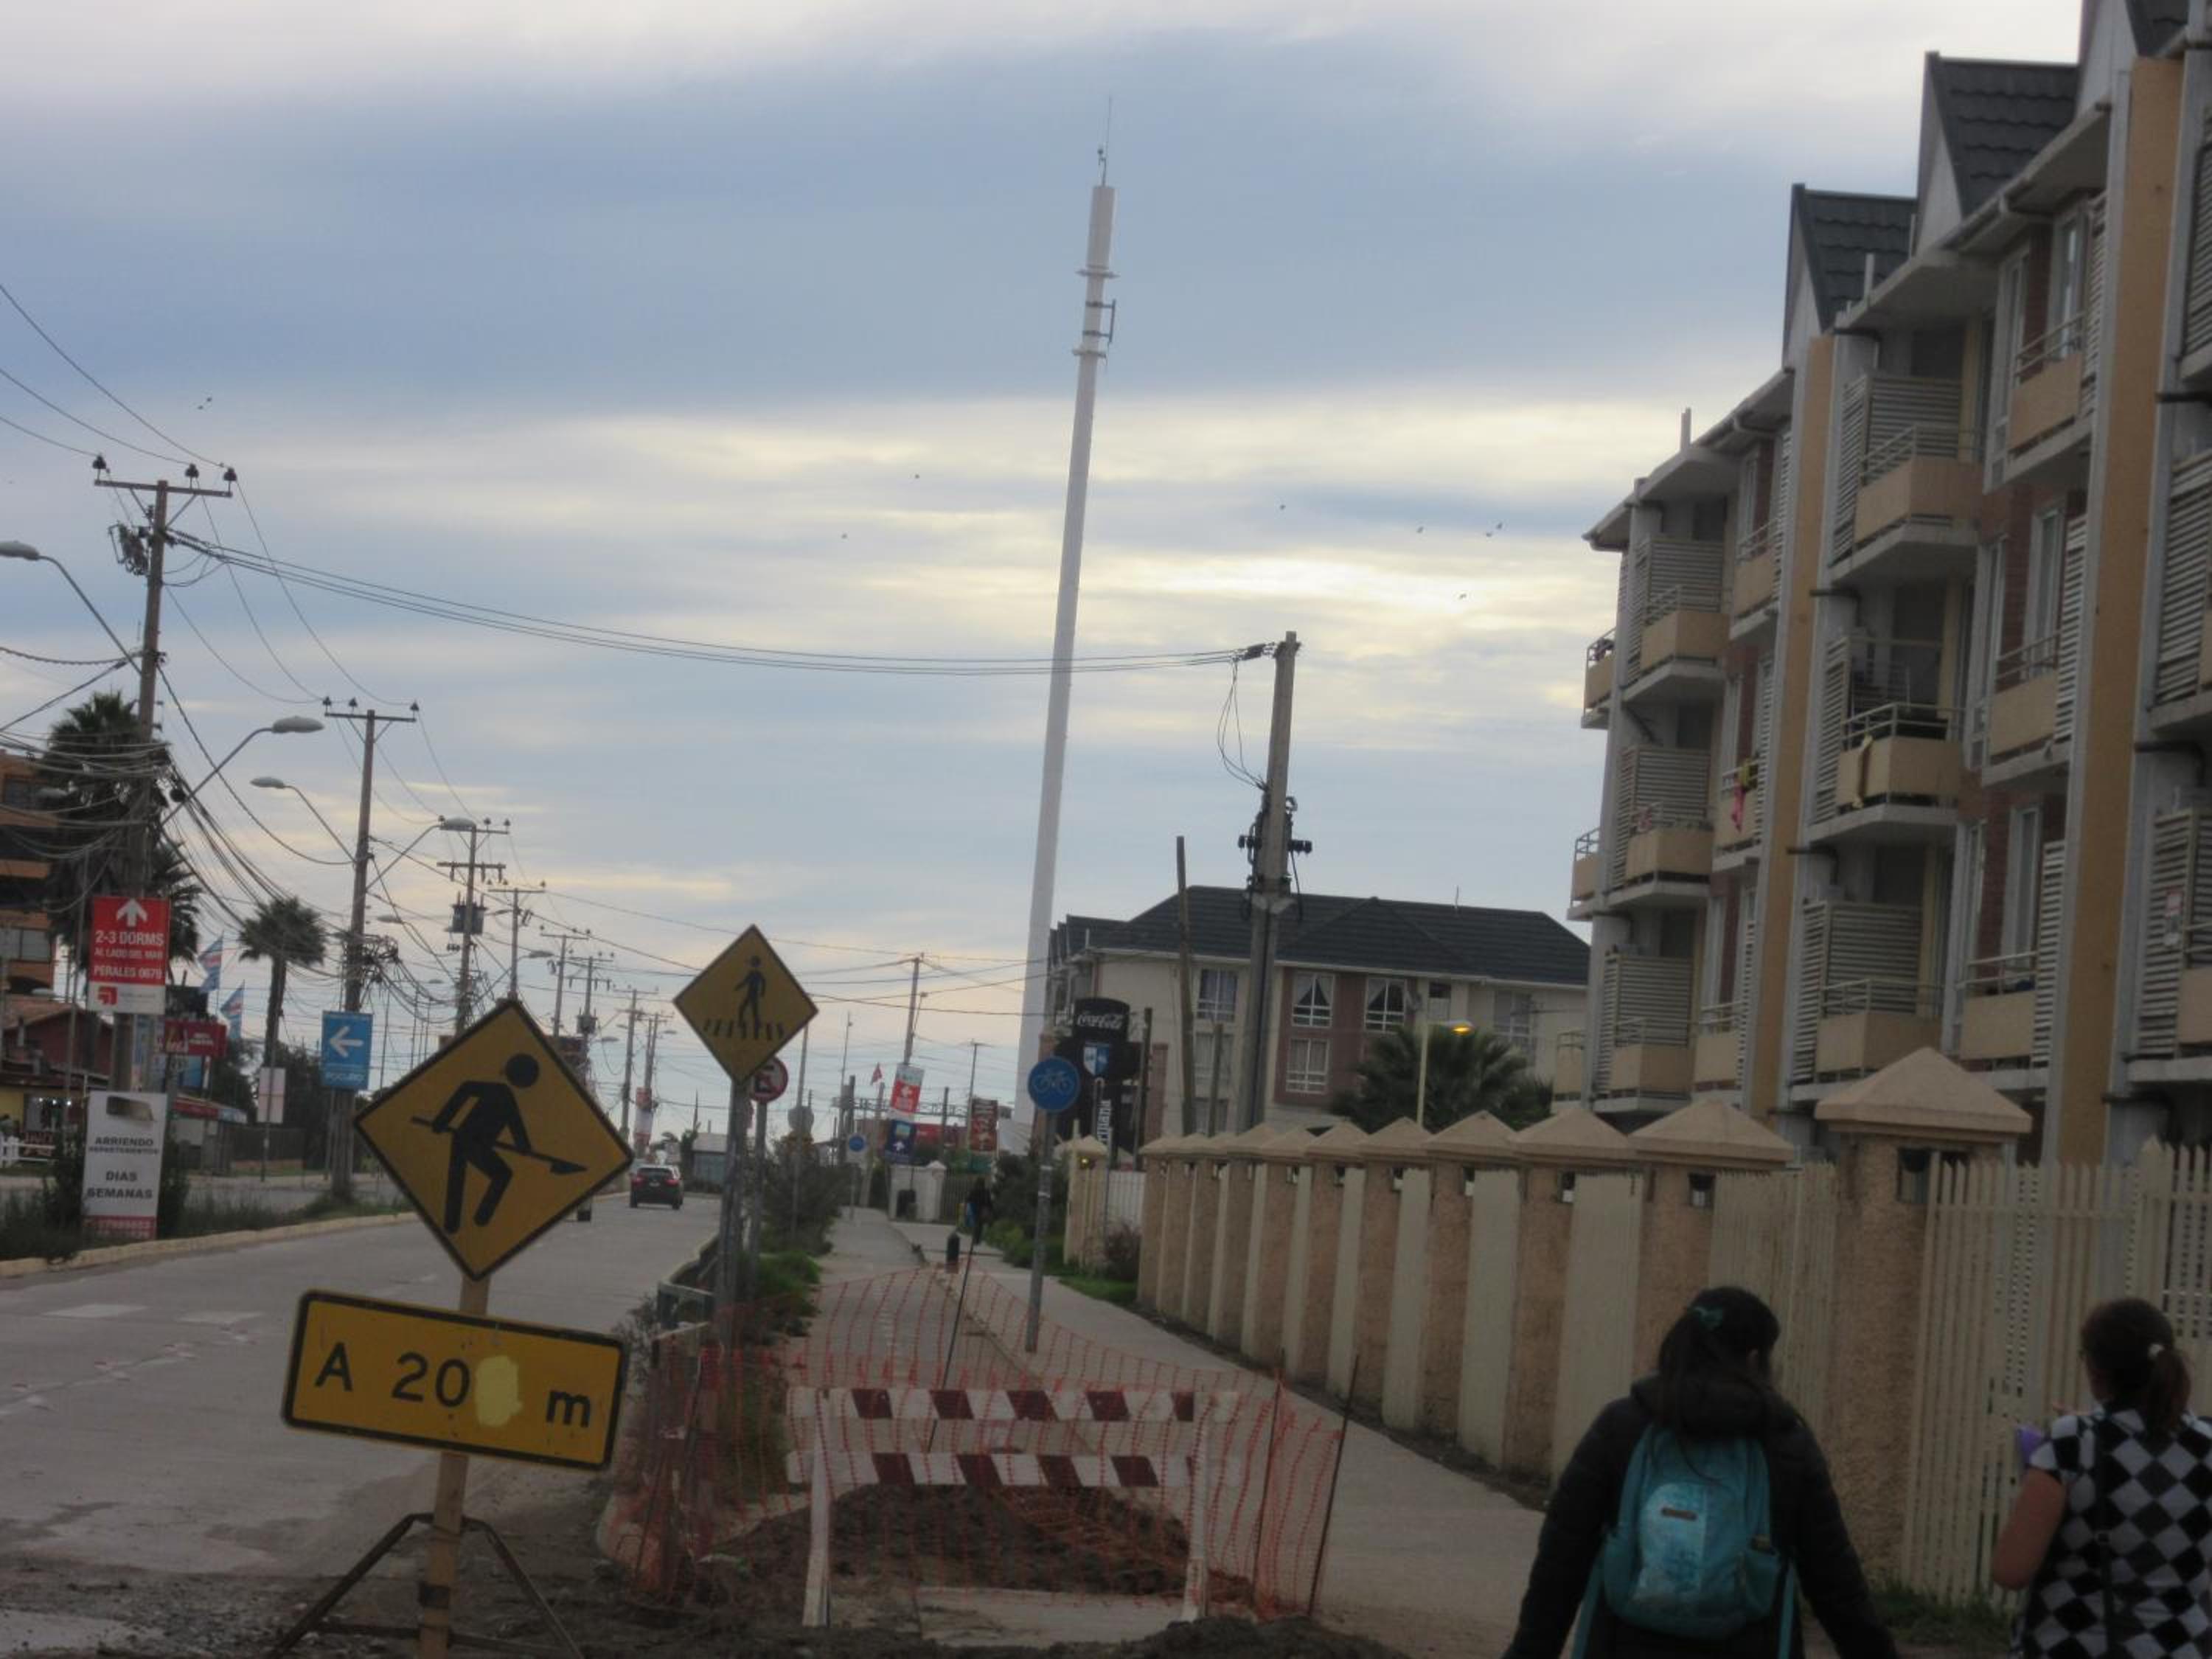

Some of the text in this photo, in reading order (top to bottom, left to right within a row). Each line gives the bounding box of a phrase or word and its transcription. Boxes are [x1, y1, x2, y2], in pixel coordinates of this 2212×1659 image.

[95, 930, 164, 946] 2-3 DORMS
[95, 1136, 154, 1147] ARRIENDO
[105, 1171, 138, 1183] DIAS
[87, 1187, 153, 1200] SEMANAS
[314, 1343, 353, 1392] A
[546, 1388, 591, 1428] m
